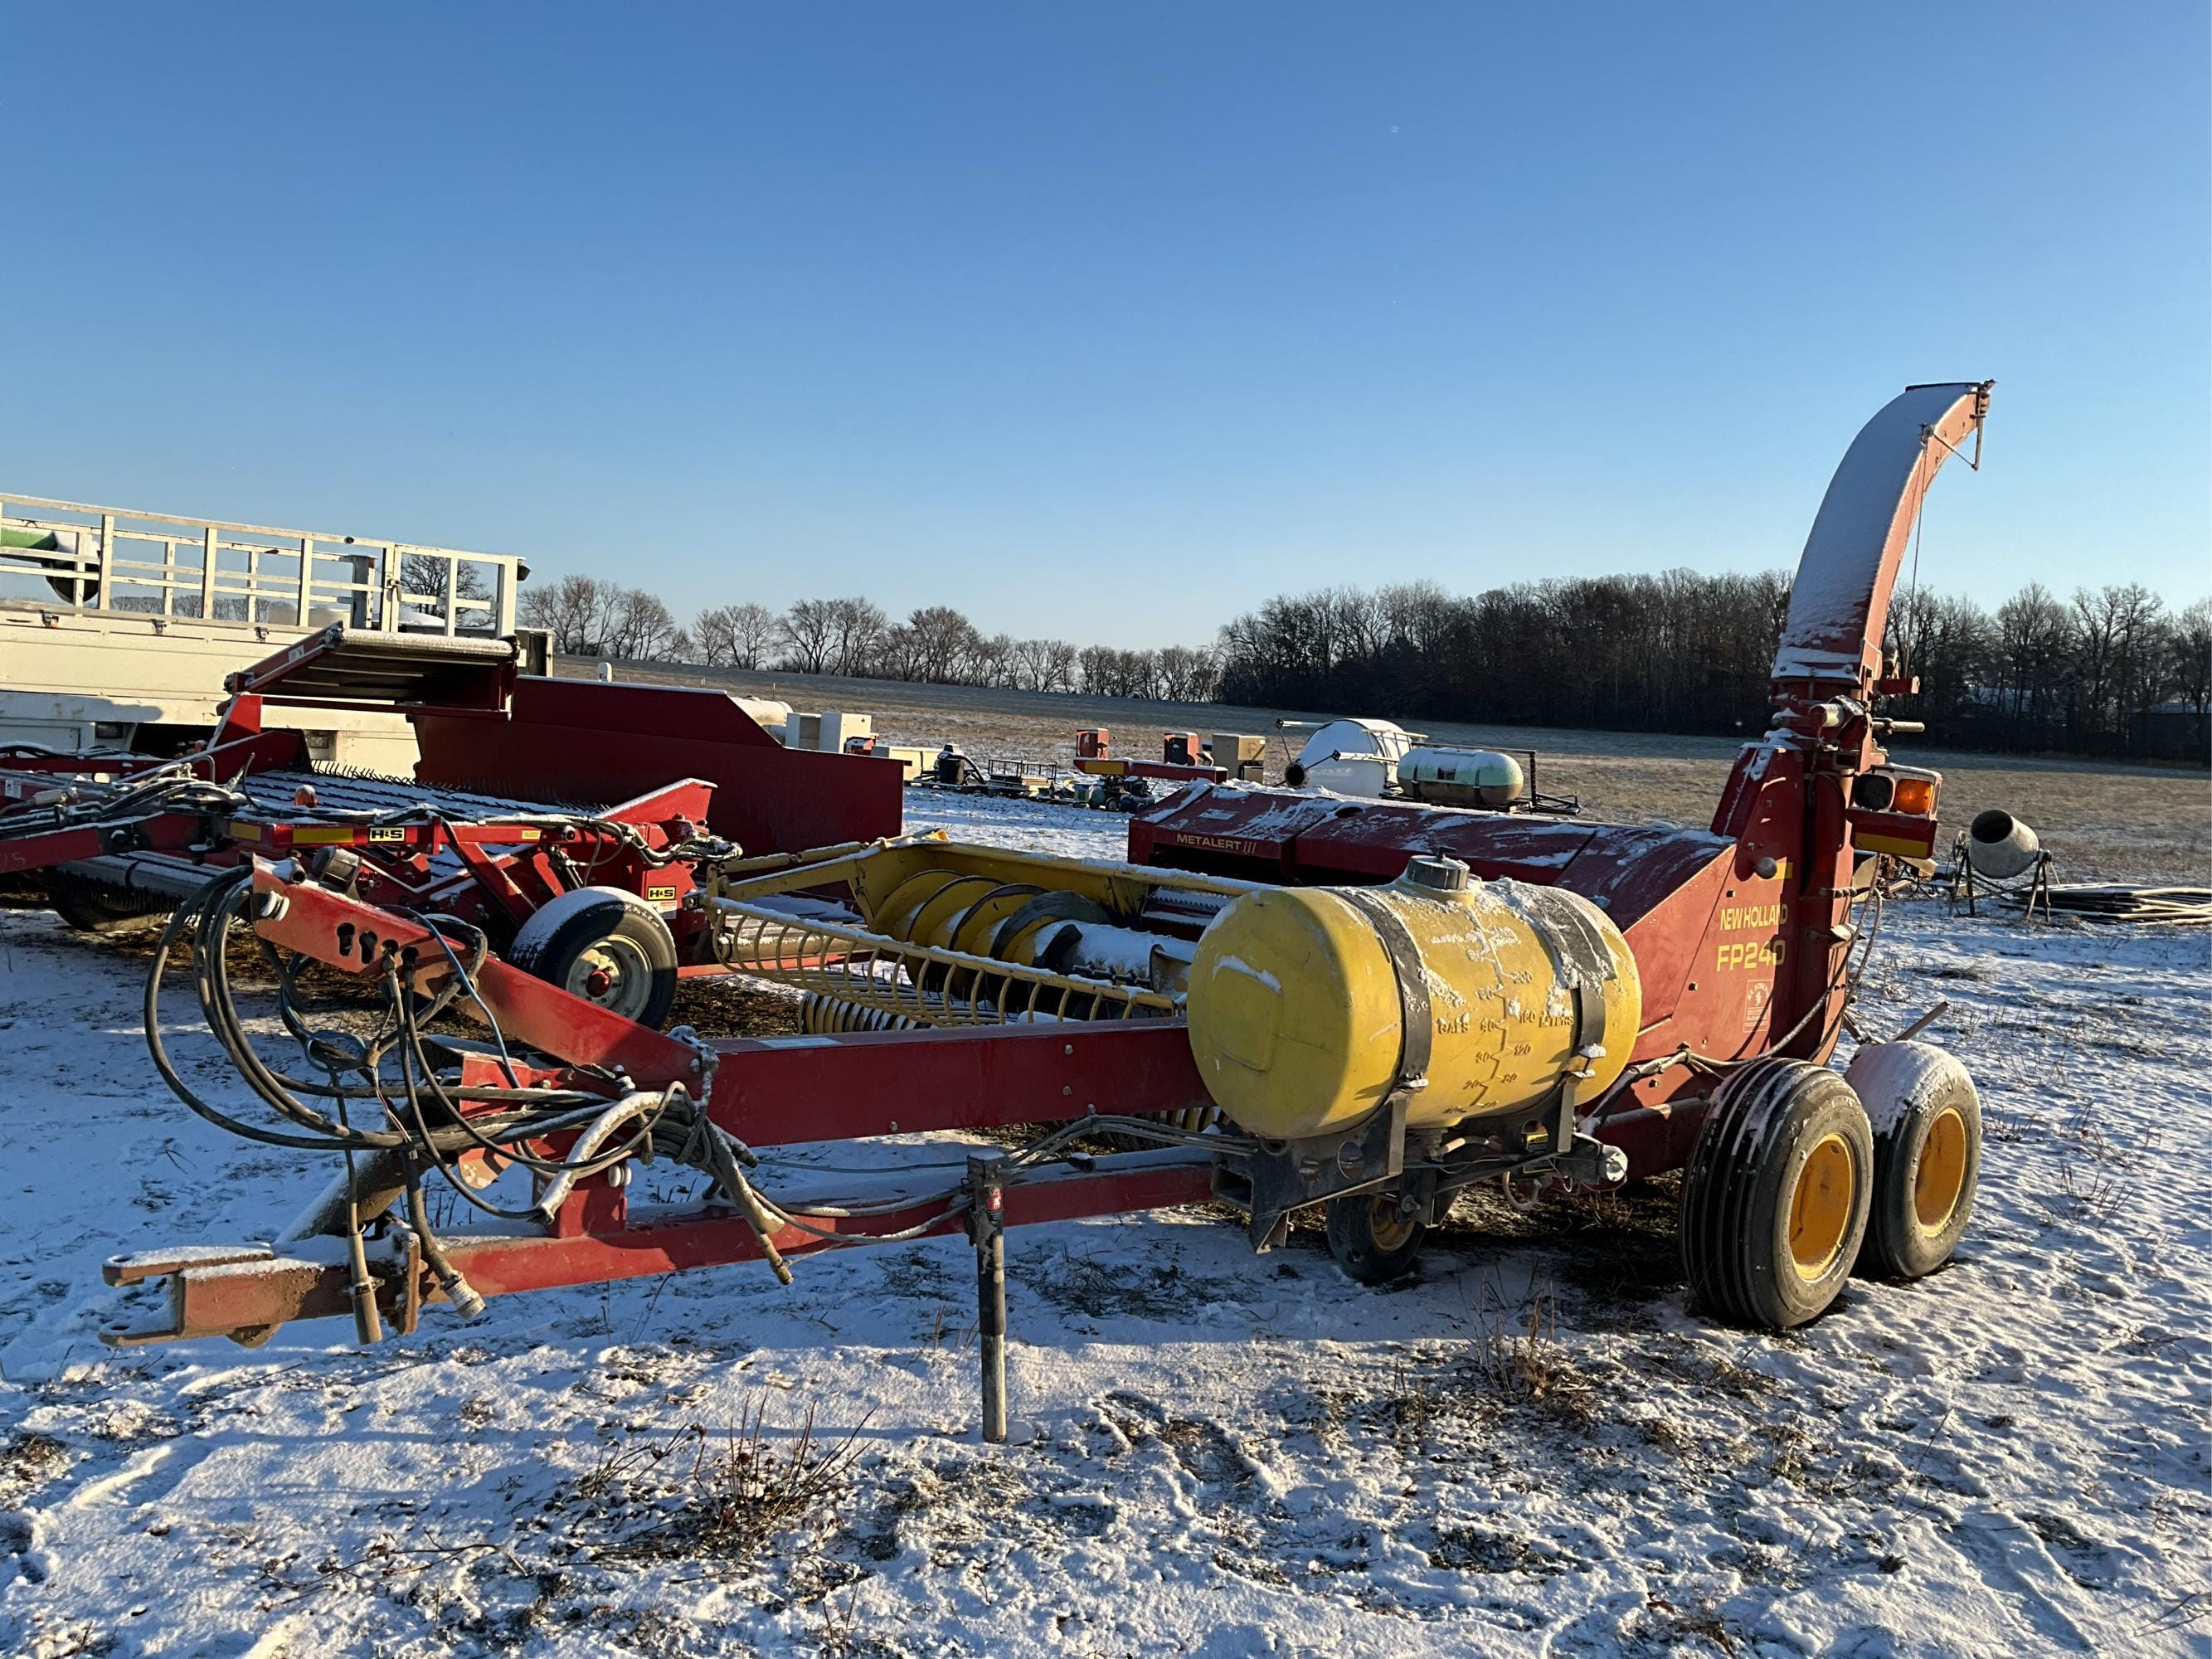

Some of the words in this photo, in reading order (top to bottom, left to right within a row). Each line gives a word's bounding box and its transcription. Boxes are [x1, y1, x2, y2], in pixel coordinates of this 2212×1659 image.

[371, 830, 403, 839] H&S
[1176, 834, 1242, 850] METALERT
[1242, 841, 1257, 854] III
[649, 889, 673, 898] H&S
[1720, 907, 1743, 931] NEW
[1743, 904, 1787, 928] HOLLAND
[1717, 940, 1786, 971] FP240
